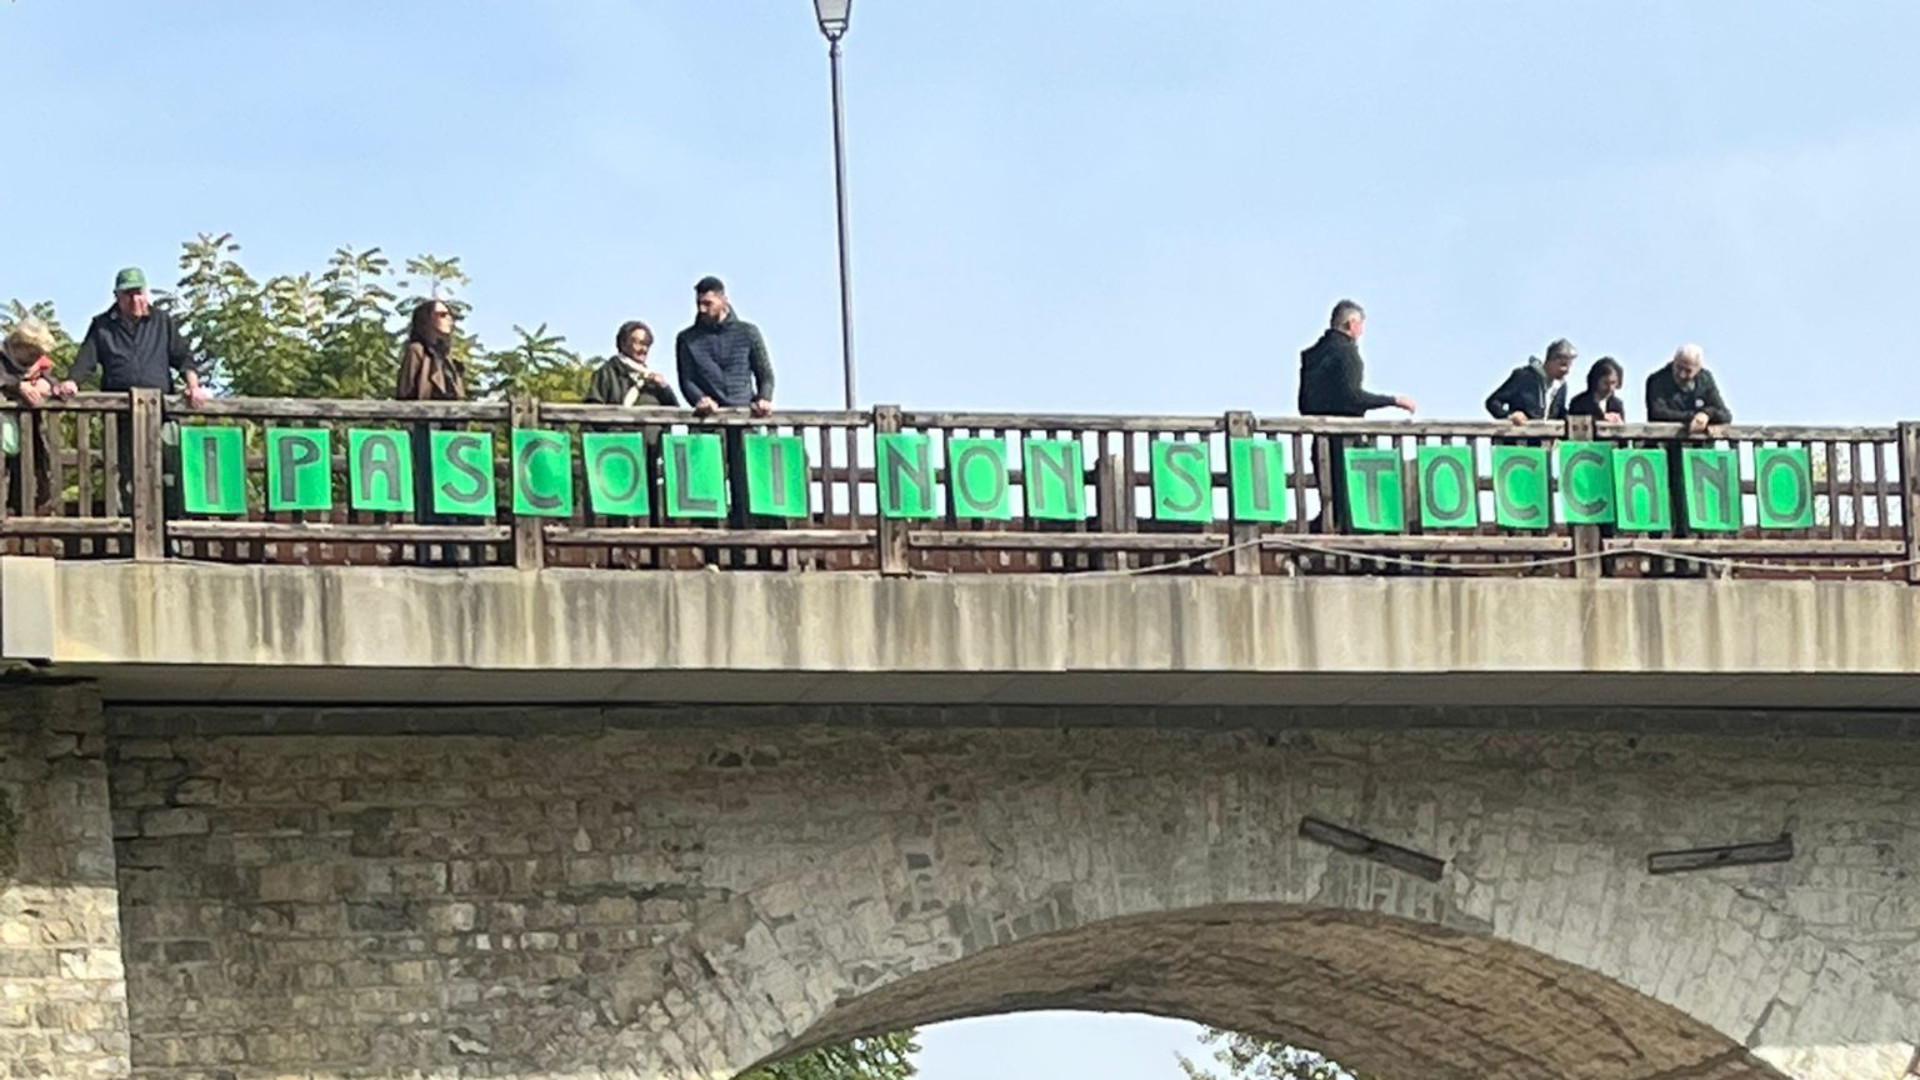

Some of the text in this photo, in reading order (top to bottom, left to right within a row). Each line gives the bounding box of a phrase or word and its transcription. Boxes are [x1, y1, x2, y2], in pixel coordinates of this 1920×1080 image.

[203, 435, 1809, 524] I PASCOLI NON SI TOCCANO
